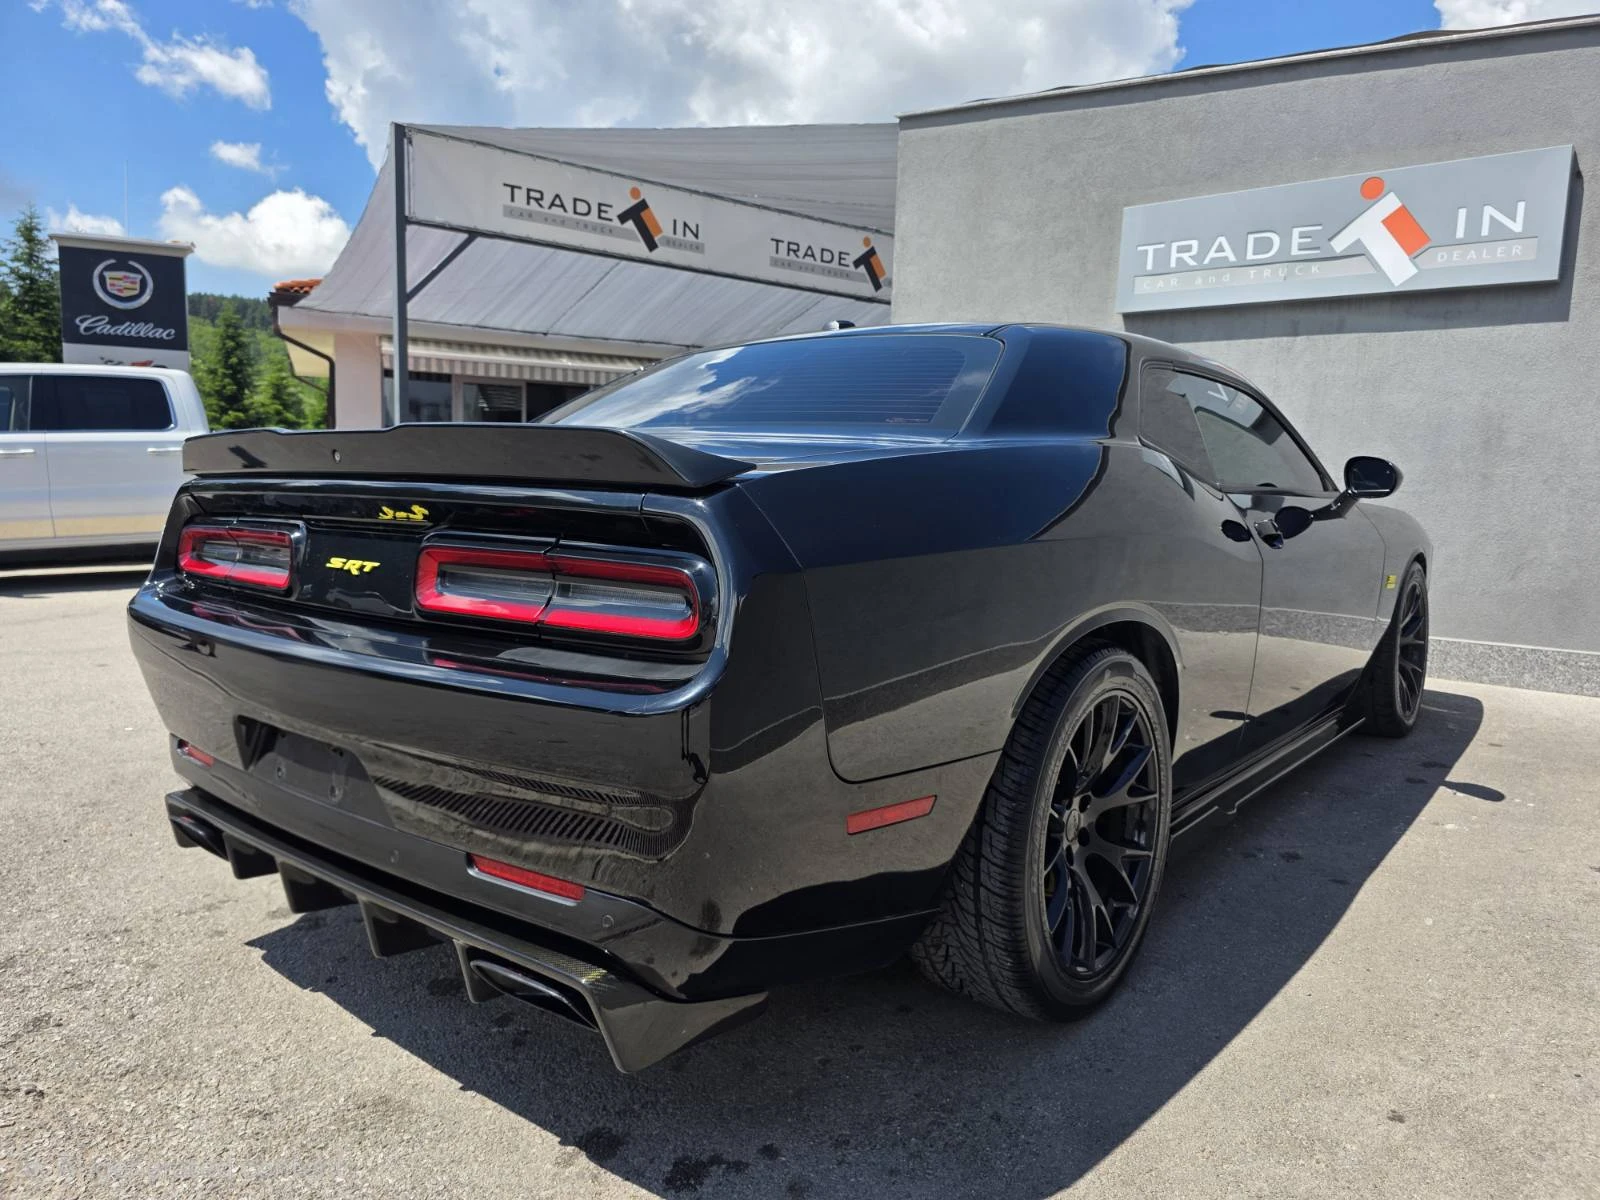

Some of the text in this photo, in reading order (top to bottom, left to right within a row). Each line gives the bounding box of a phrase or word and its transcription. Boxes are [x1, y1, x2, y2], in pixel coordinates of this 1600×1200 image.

[503, 183, 614, 222] TRADE
[672, 219, 700, 240] IN
[1136, 224, 1324, 271] TRADE
[1455, 201, 1527, 239] IN
[770, 237, 851, 267] TRADE
[1437, 244, 1523, 262] DEALER
[1142, 263, 1321, 290] CAR and TRUCK
[75, 315, 176, 340] Cadillac
[325, 557, 381, 575] SRT
